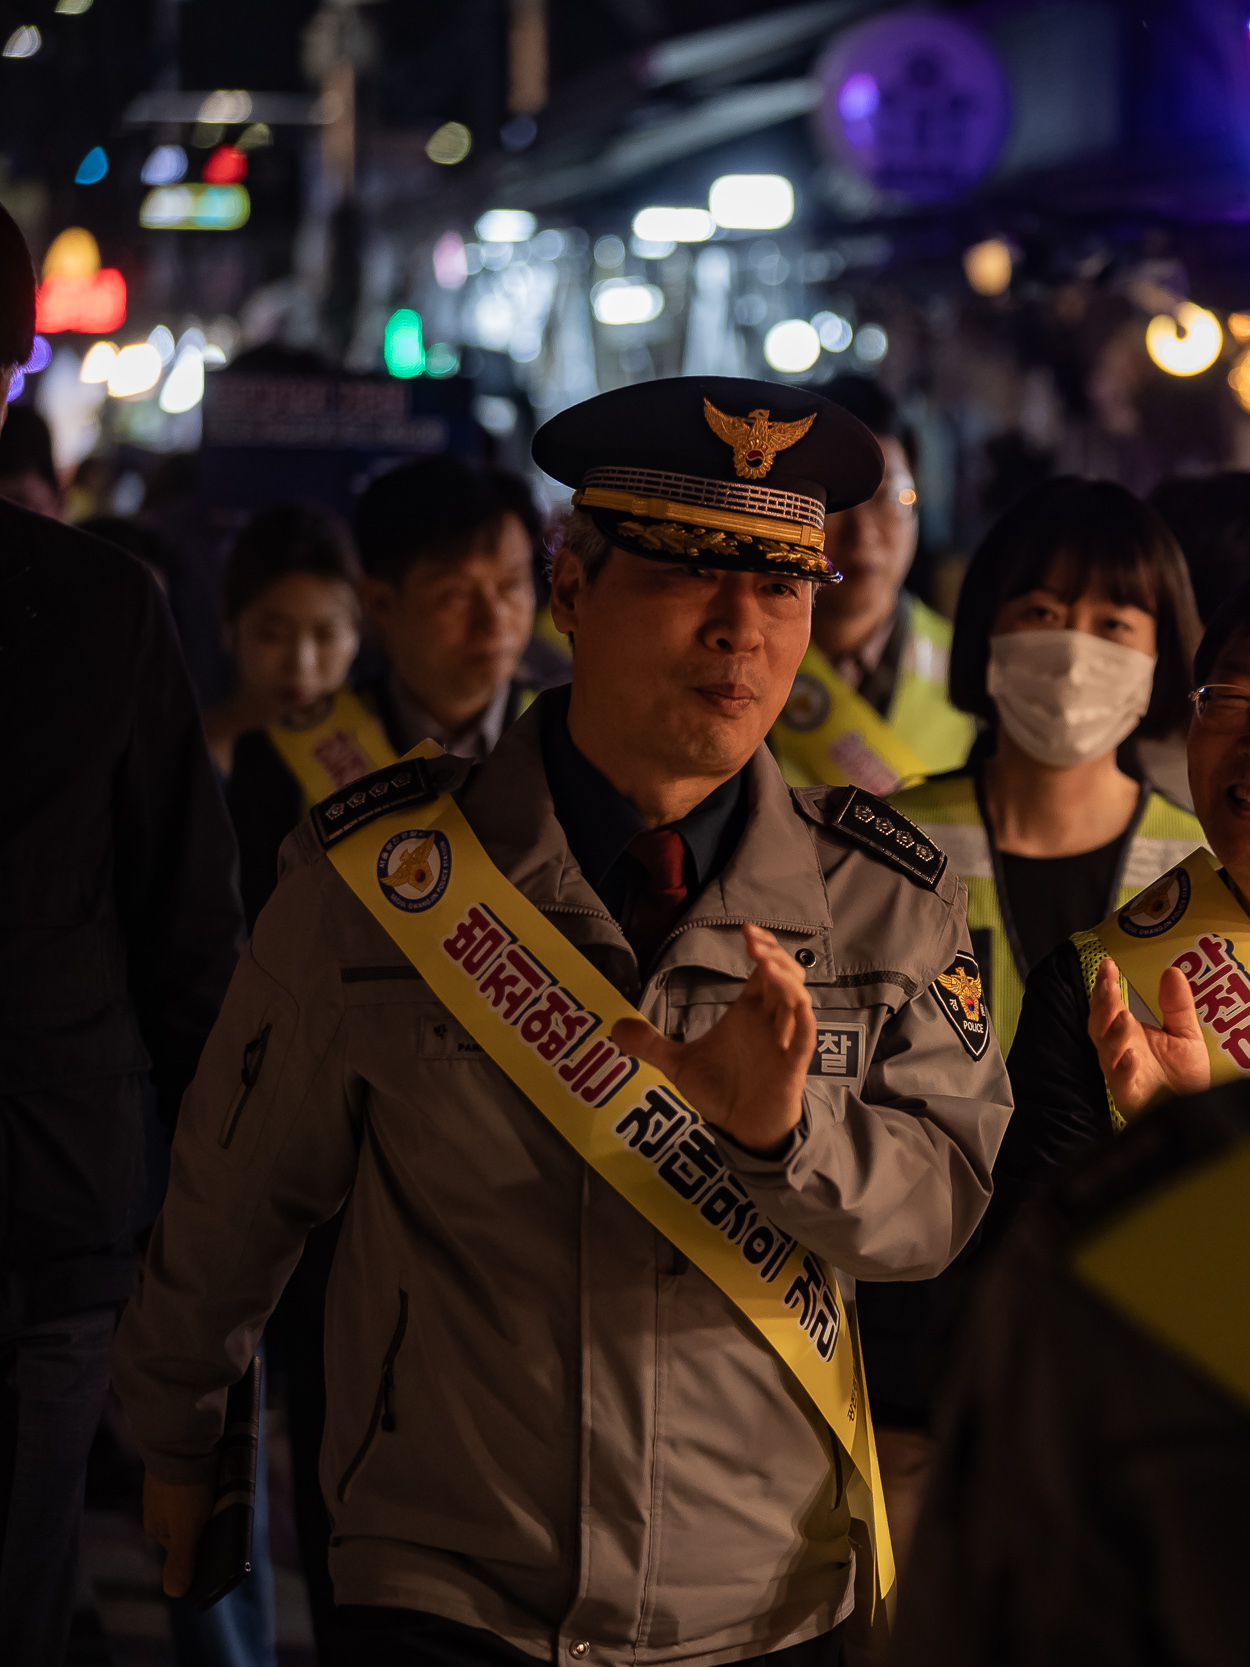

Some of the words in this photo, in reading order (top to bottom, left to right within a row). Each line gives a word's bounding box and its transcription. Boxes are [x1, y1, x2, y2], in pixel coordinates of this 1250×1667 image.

[439, 840, 449, 867] STATION
[437, 868, 449, 892] POLICE
[390, 893, 407, 909] SEOUL
[408, 892, 439, 910] GWANGJIN
[441, 903, 638, 1107] 범죄없는
[963, 1020, 984, 1033] POLICE
[817, 1031, 852, 1075] 찰
